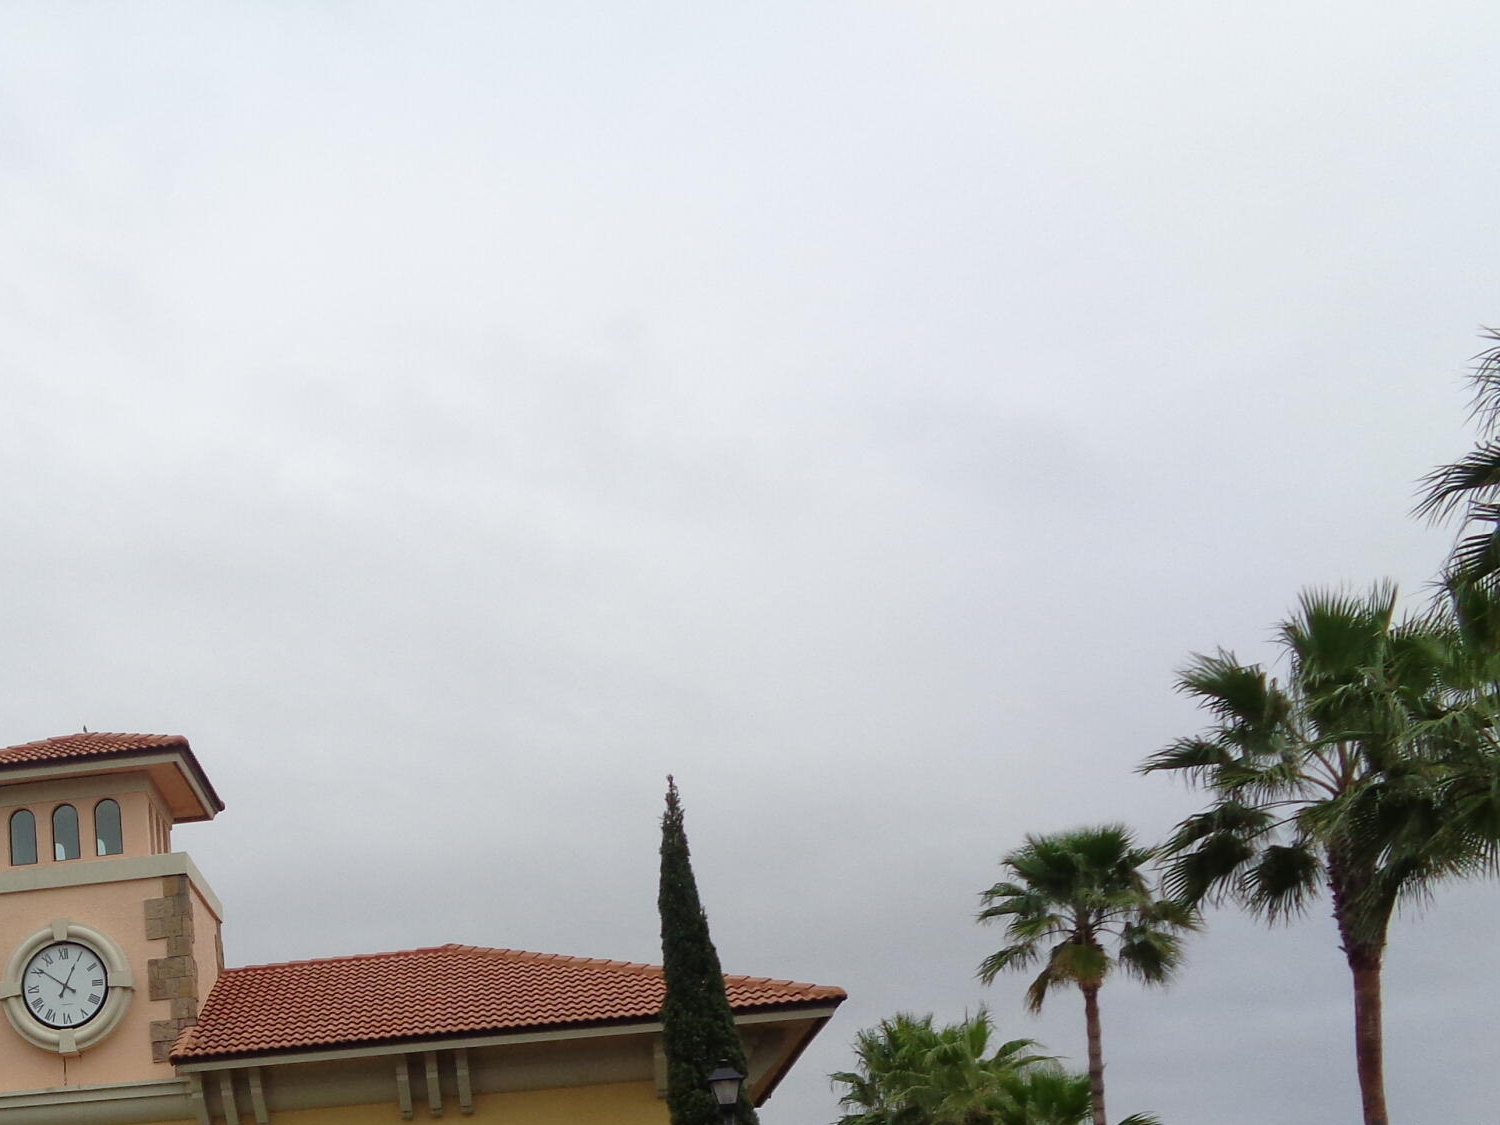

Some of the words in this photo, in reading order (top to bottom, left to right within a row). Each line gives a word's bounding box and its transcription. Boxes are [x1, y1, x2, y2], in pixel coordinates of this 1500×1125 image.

[59, 948, 69, 960] XII
[41, 953, 54, 967] XI
[86, 962, 98, 972] II
[91, 979, 103, 987] III
[28, 985, 39, 994] IX
[45, 1009, 56, 1023] VII
[63, 1012, 73, 1024] VI
[80, 1008, 89, 1019] V
